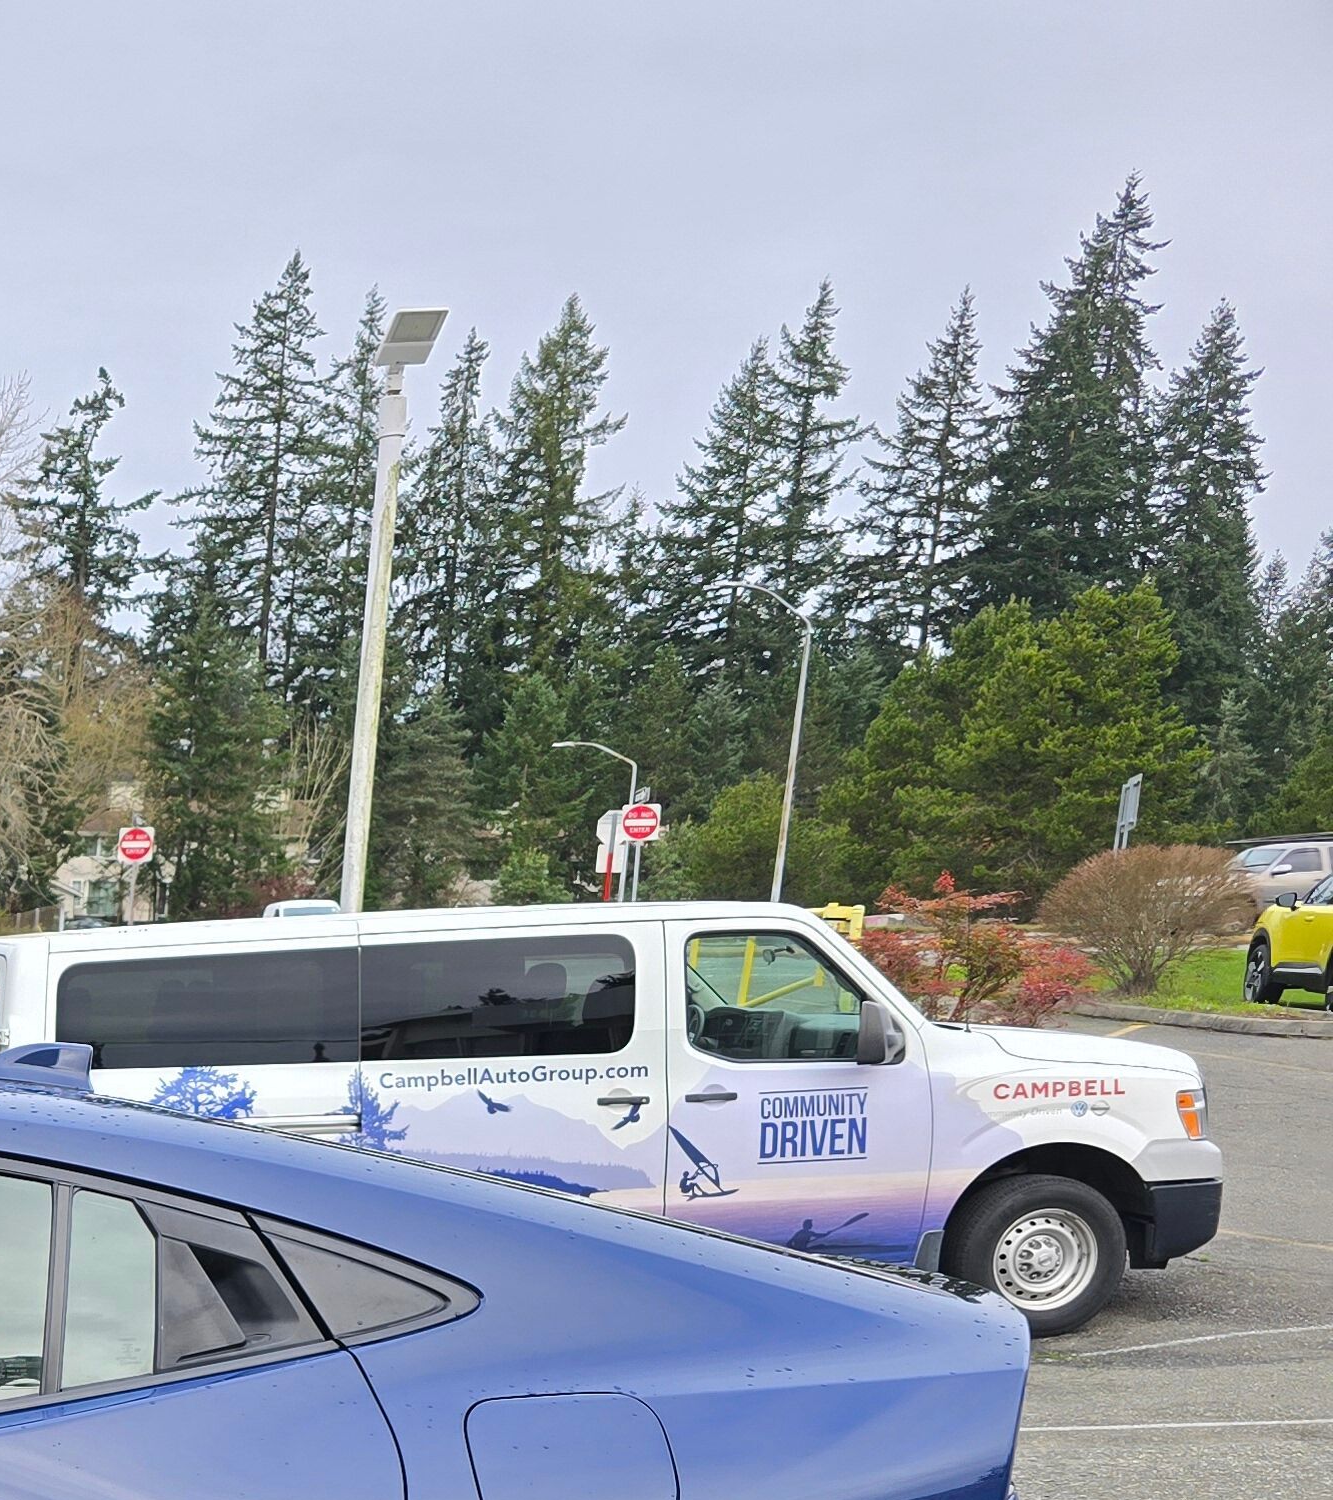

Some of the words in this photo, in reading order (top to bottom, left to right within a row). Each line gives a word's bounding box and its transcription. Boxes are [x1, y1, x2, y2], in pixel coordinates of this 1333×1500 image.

[379, 1065, 649, 1092] CampbellAutoGroup.com
[992, 1078, 1127, 1100] CAMPBELL
[760, 1092, 868, 1120] COMMUNITY
[759, 1116, 867, 1159] DRIVEN
